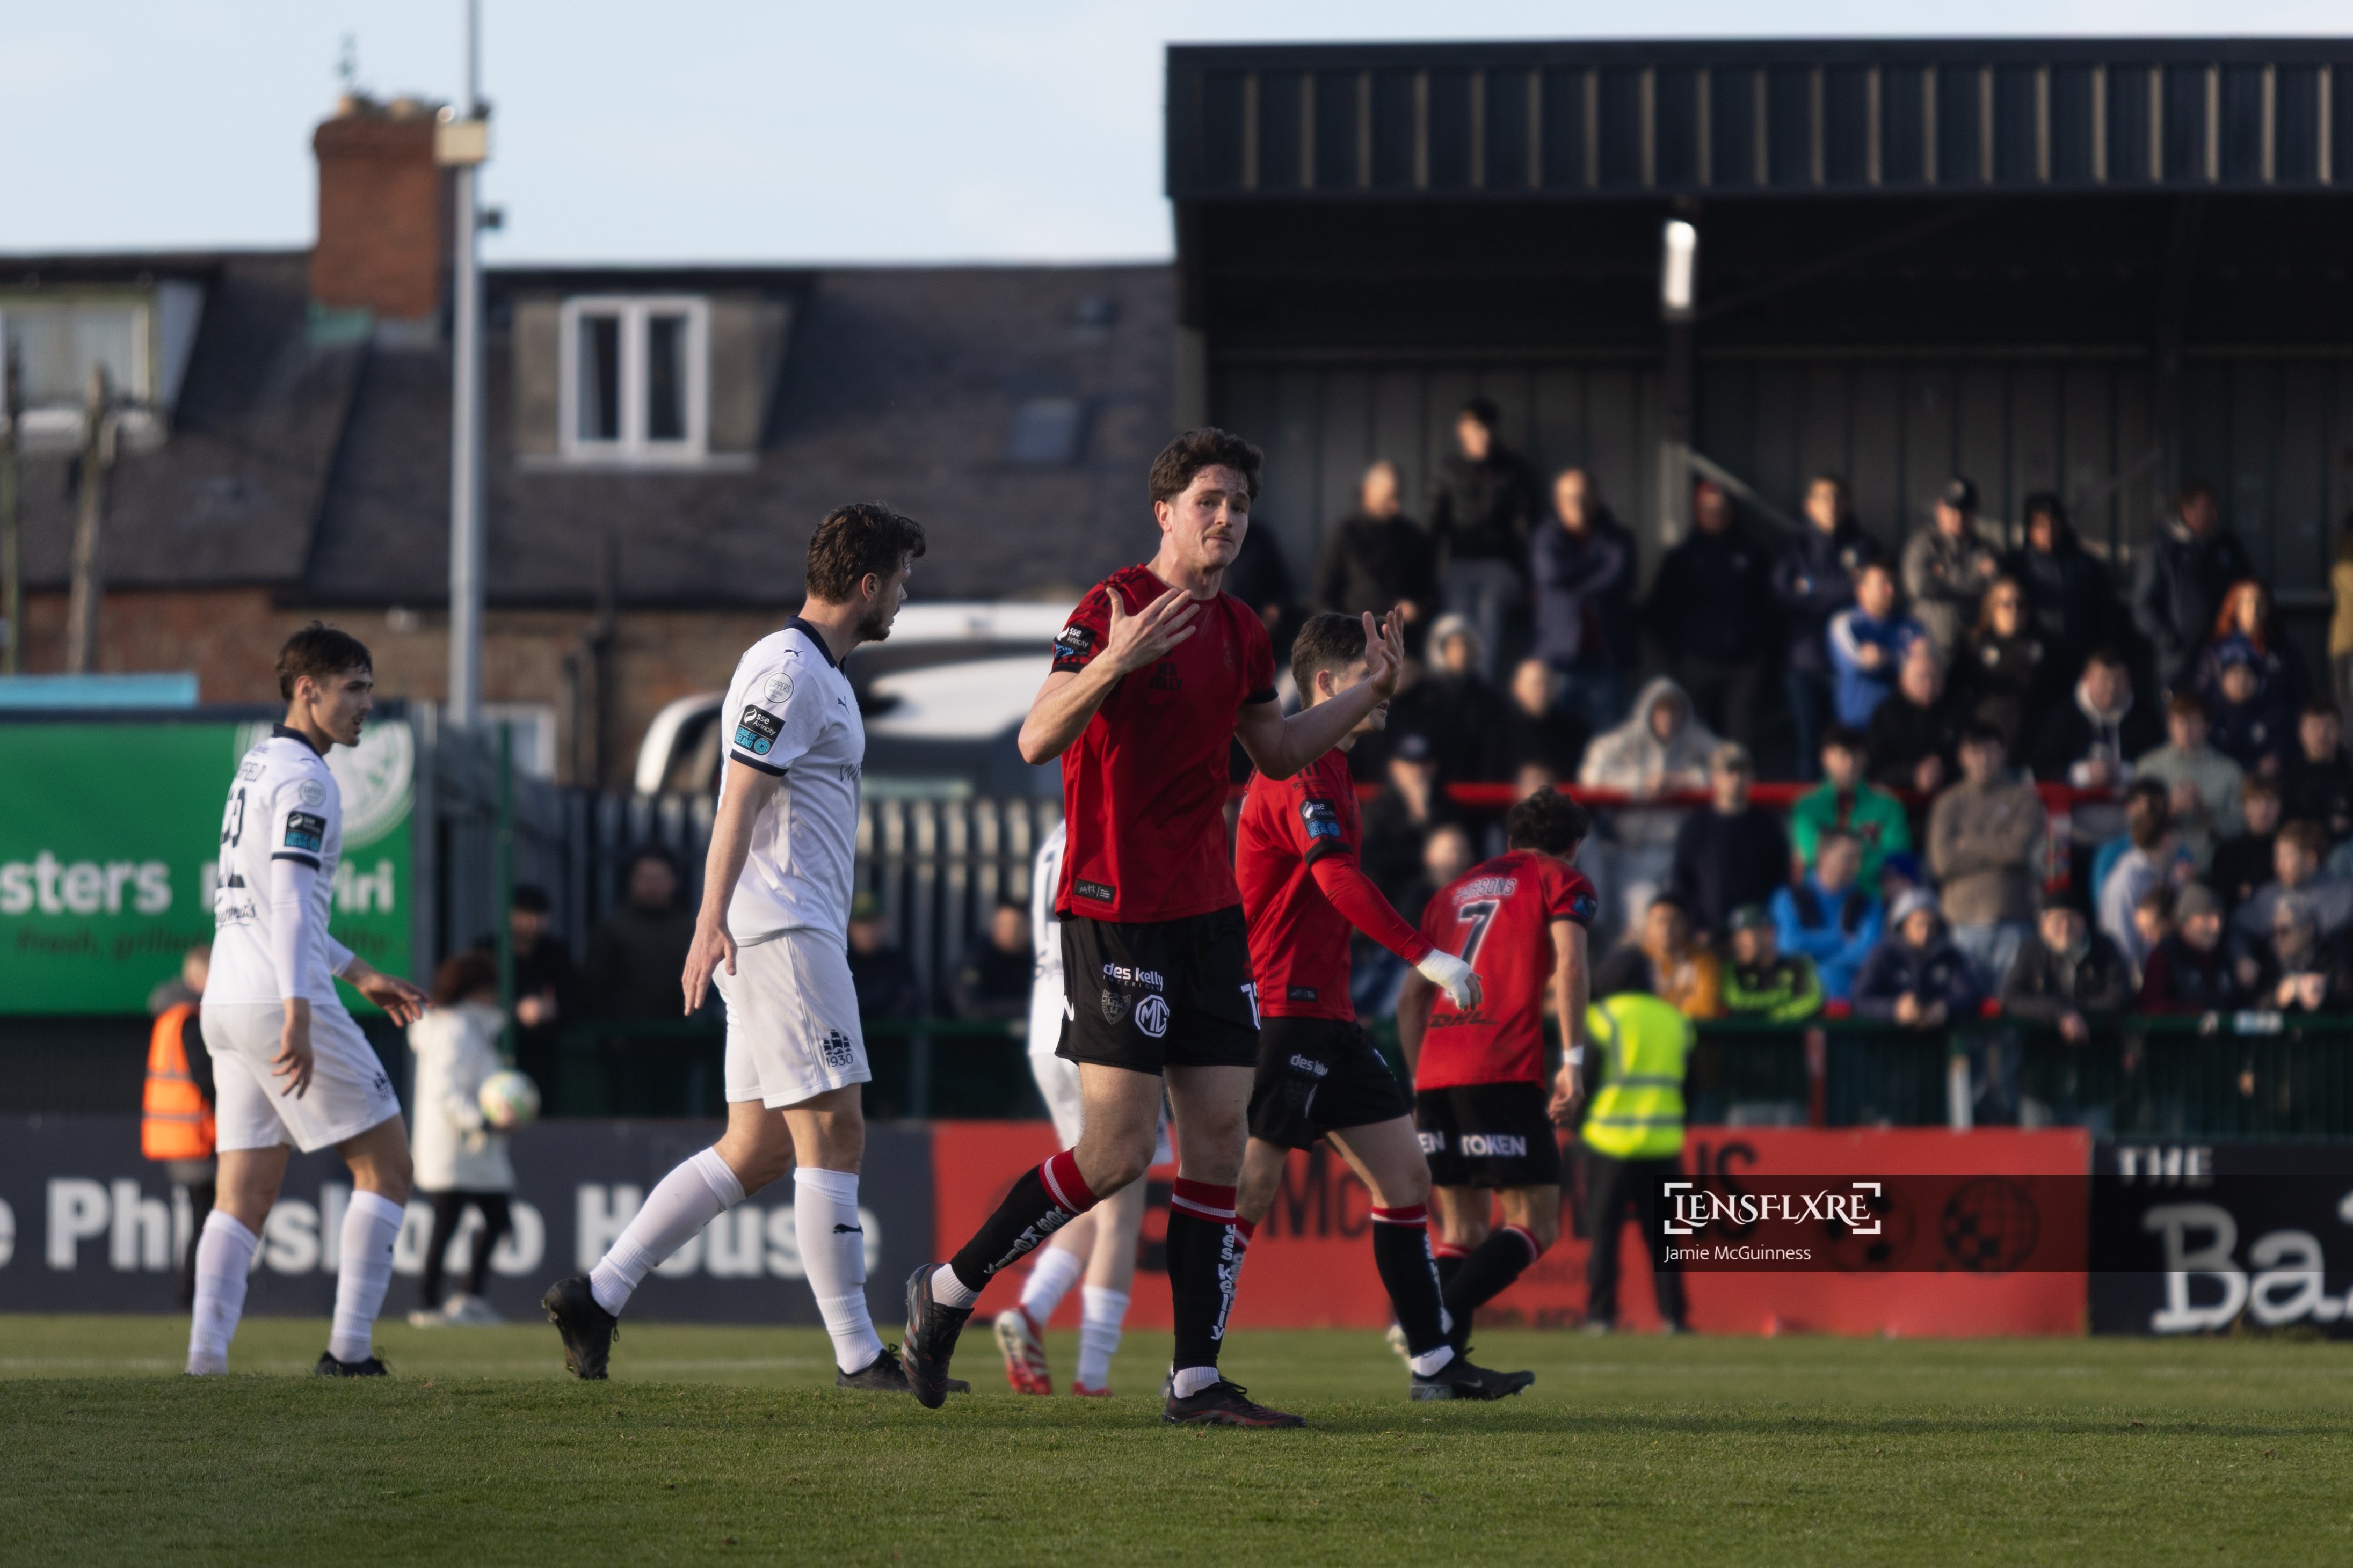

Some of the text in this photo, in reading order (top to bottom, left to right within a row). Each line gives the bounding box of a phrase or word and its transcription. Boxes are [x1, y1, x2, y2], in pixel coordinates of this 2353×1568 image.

[1069, 627, 1082, 637] sse
[1066, 636, 1090, 649] Airtricity
[768, 678, 791, 694] COPPERS
[752, 720, 776, 735] Airtricity
[756, 713, 770, 725] sse
[749, 731, 758, 740] OF
[1453, 878, 1517, 905] PARSONS
[1444, 899, 1500, 1000] 7
[1102, 974, 1160, 991] INTERIORS
[1103, 962, 1163, 992] des kelly
[1139, 999, 1168, 1033] MG
[1428, 1011, 1498, 1027] DHL
[826, 1053, 854, 1068] 1930
[1290, 1054, 1314, 1071] des
[1461, 1135, 1527, 1157] TOKEN
[984, 1225, 1044, 1274] kelly
[1211, 1264, 1233, 1340] kelly
